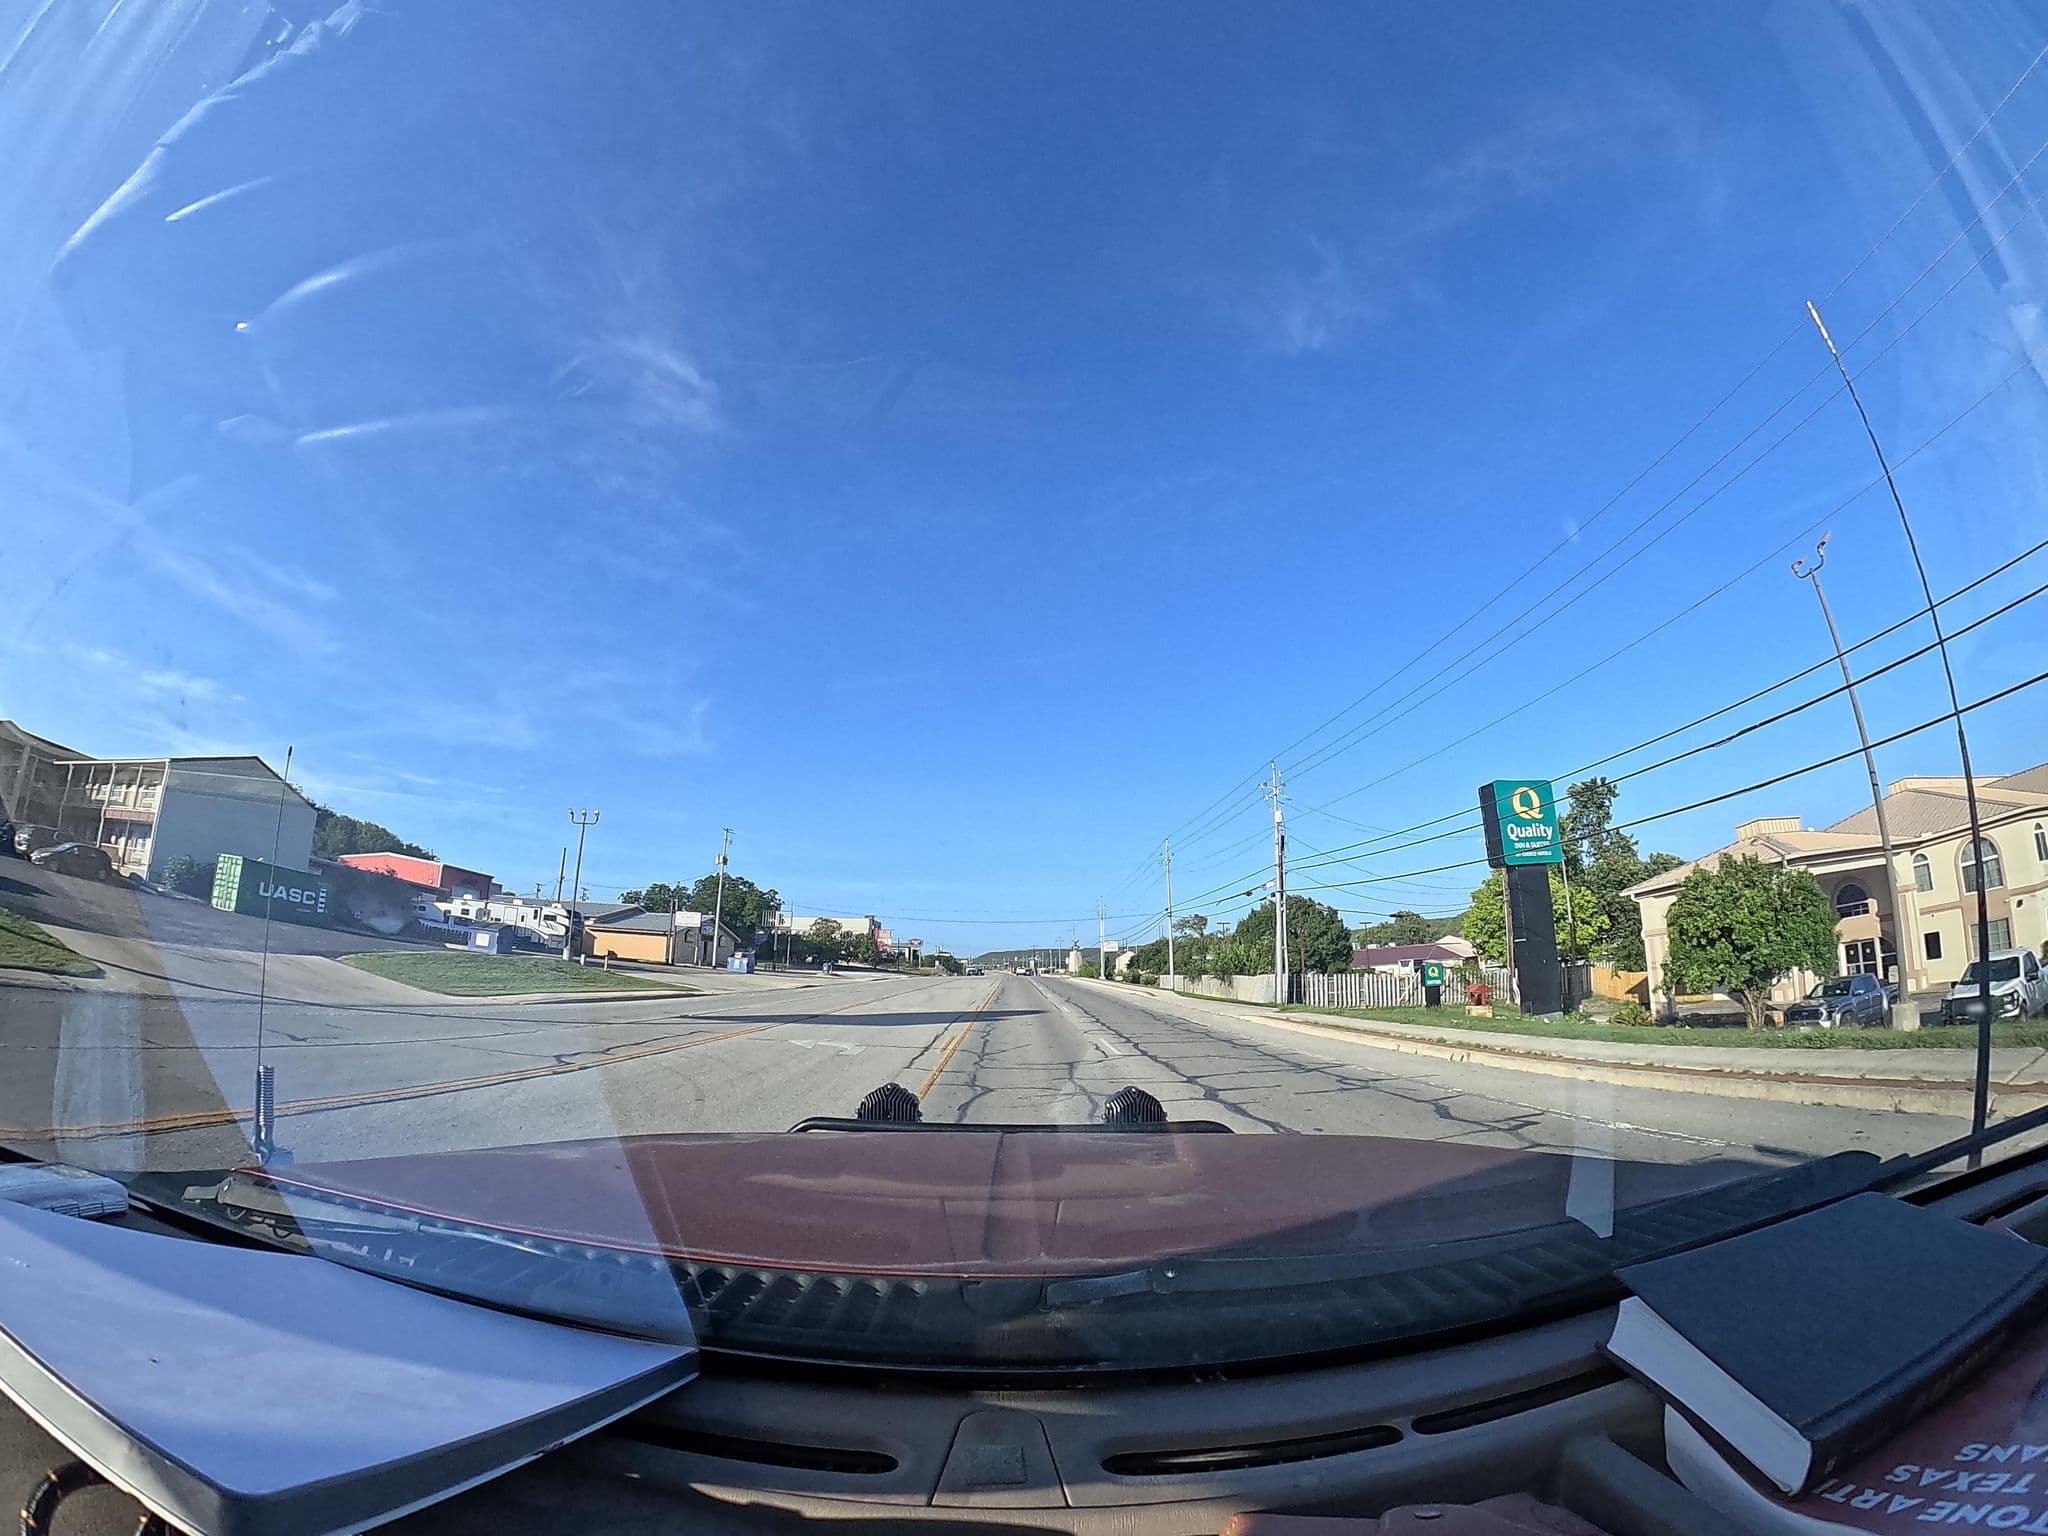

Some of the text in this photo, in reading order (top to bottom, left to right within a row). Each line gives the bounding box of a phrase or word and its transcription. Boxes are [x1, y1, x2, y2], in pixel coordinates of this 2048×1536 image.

[1512, 786, 1544, 819] Q
[1507, 823, 1553, 841] Quality
[258, 881, 316, 905] UASC
[1954, 1442, 2048, 1464] ANS
[1884, 1463, 2036, 1494] TEXAS
